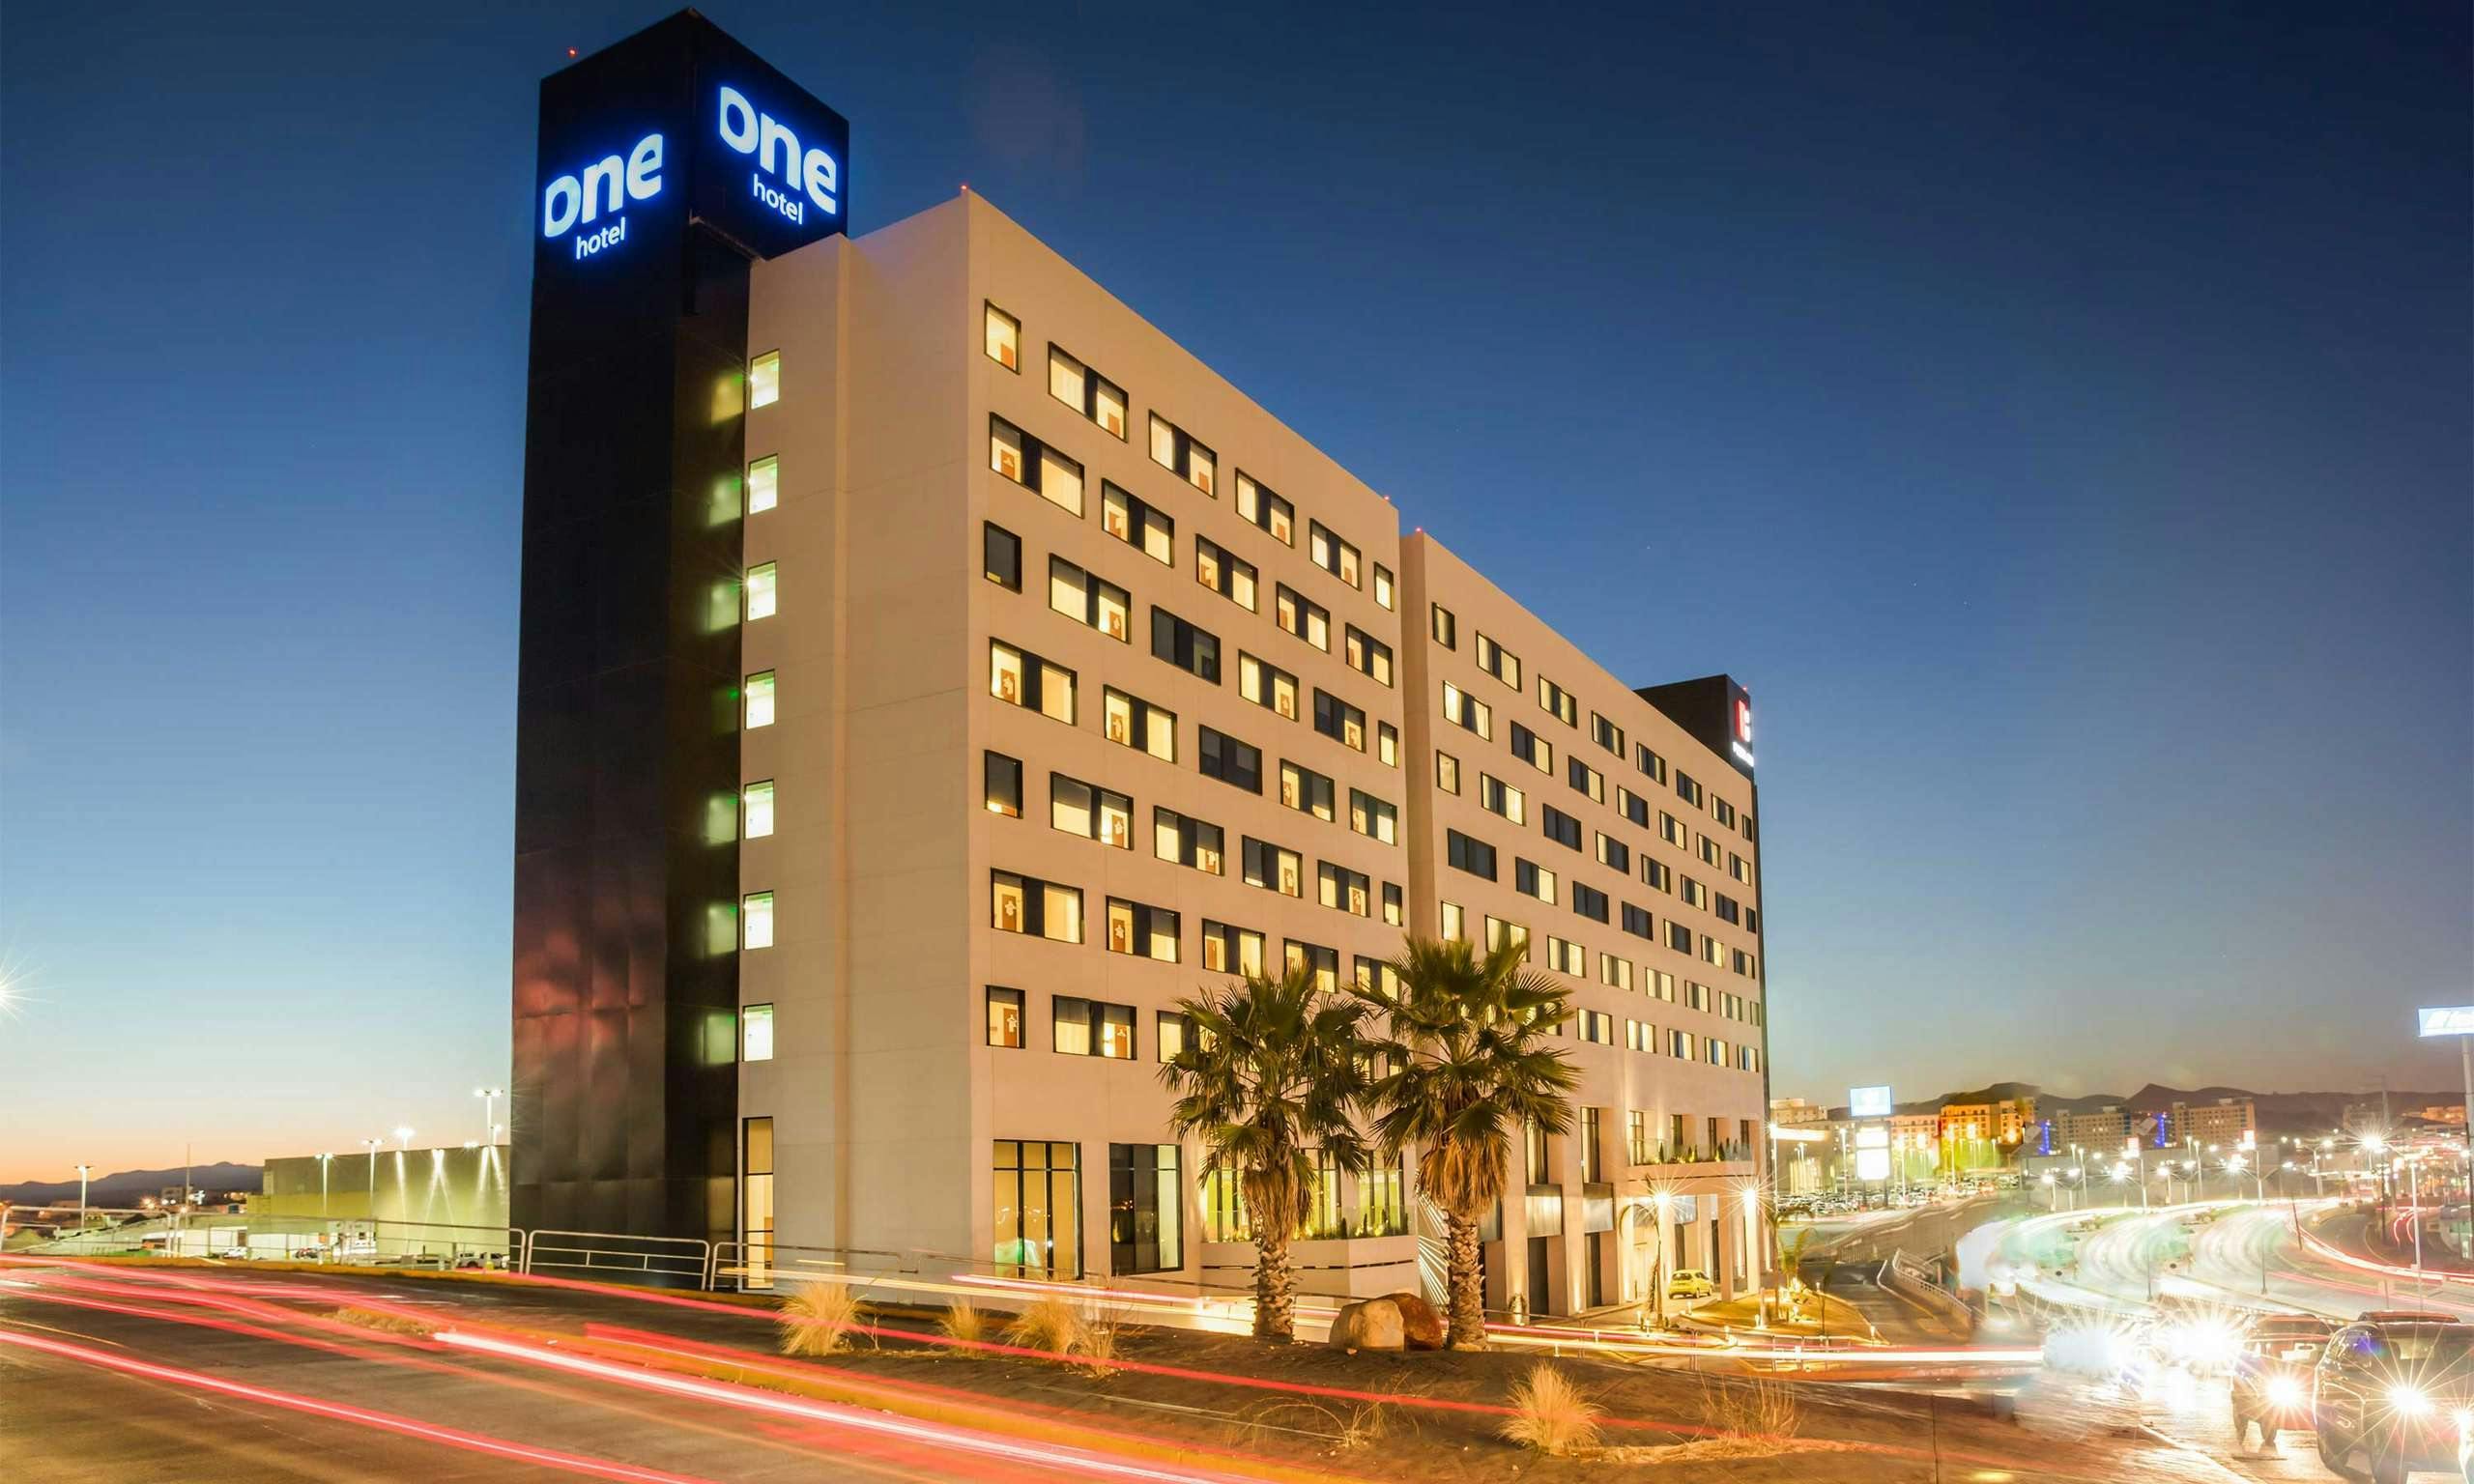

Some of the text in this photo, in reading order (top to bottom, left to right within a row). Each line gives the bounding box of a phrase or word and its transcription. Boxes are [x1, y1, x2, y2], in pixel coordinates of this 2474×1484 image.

[544, 133, 663, 238] one
[719, 86, 837, 214] one
[576, 216, 626, 260] hotel
[753, 173, 803, 225] hotel
